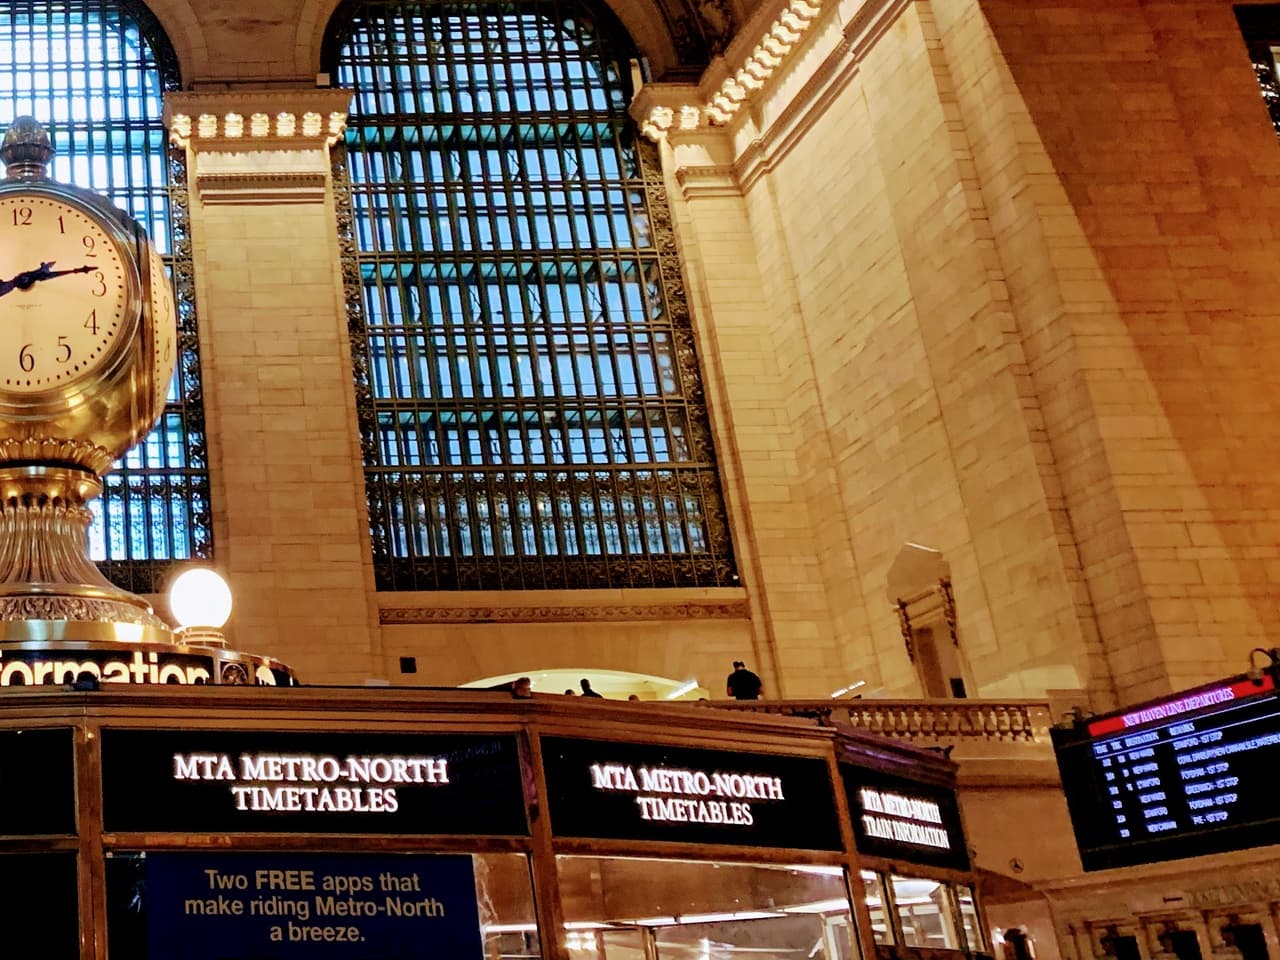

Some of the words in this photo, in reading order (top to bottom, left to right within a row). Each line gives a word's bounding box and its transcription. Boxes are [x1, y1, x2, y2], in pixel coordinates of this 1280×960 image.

[12, 207, 32, 226] 12
[57, 216, 65, 234] 1
[83, 235, 97, 257] 2
[92, 271, 107, 297] 3
[84, 308, 100, 335] 4
[19, 344, 35, 372] 6
[56, 336, 72, 363] 5
[174, 755, 236, 780] MTA
[242, 756, 449, 783] METRO-NORTH
[592, 764, 639, 790] MTA
[640, 767, 785, 800] METRO-NORTH
[232, 787, 398, 812] TIMETABLES
[637, 796, 753, 826] TIMETABLES
[863, 814, 895, 840] TRAIN
[892, 820, 950, 849] INFORMATION
[204, 869, 248, 890] Two
[255, 870, 316, 890] FREE
[322, 875, 374, 895] apps
[379, 872, 421, 892] that
[184, 895, 244, 915] make
[250, 895, 309, 920] riding
[315, 895, 445, 917] Metro-North
[270, 925, 283, 941] a
[288, 921, 366, 942] breeze.
